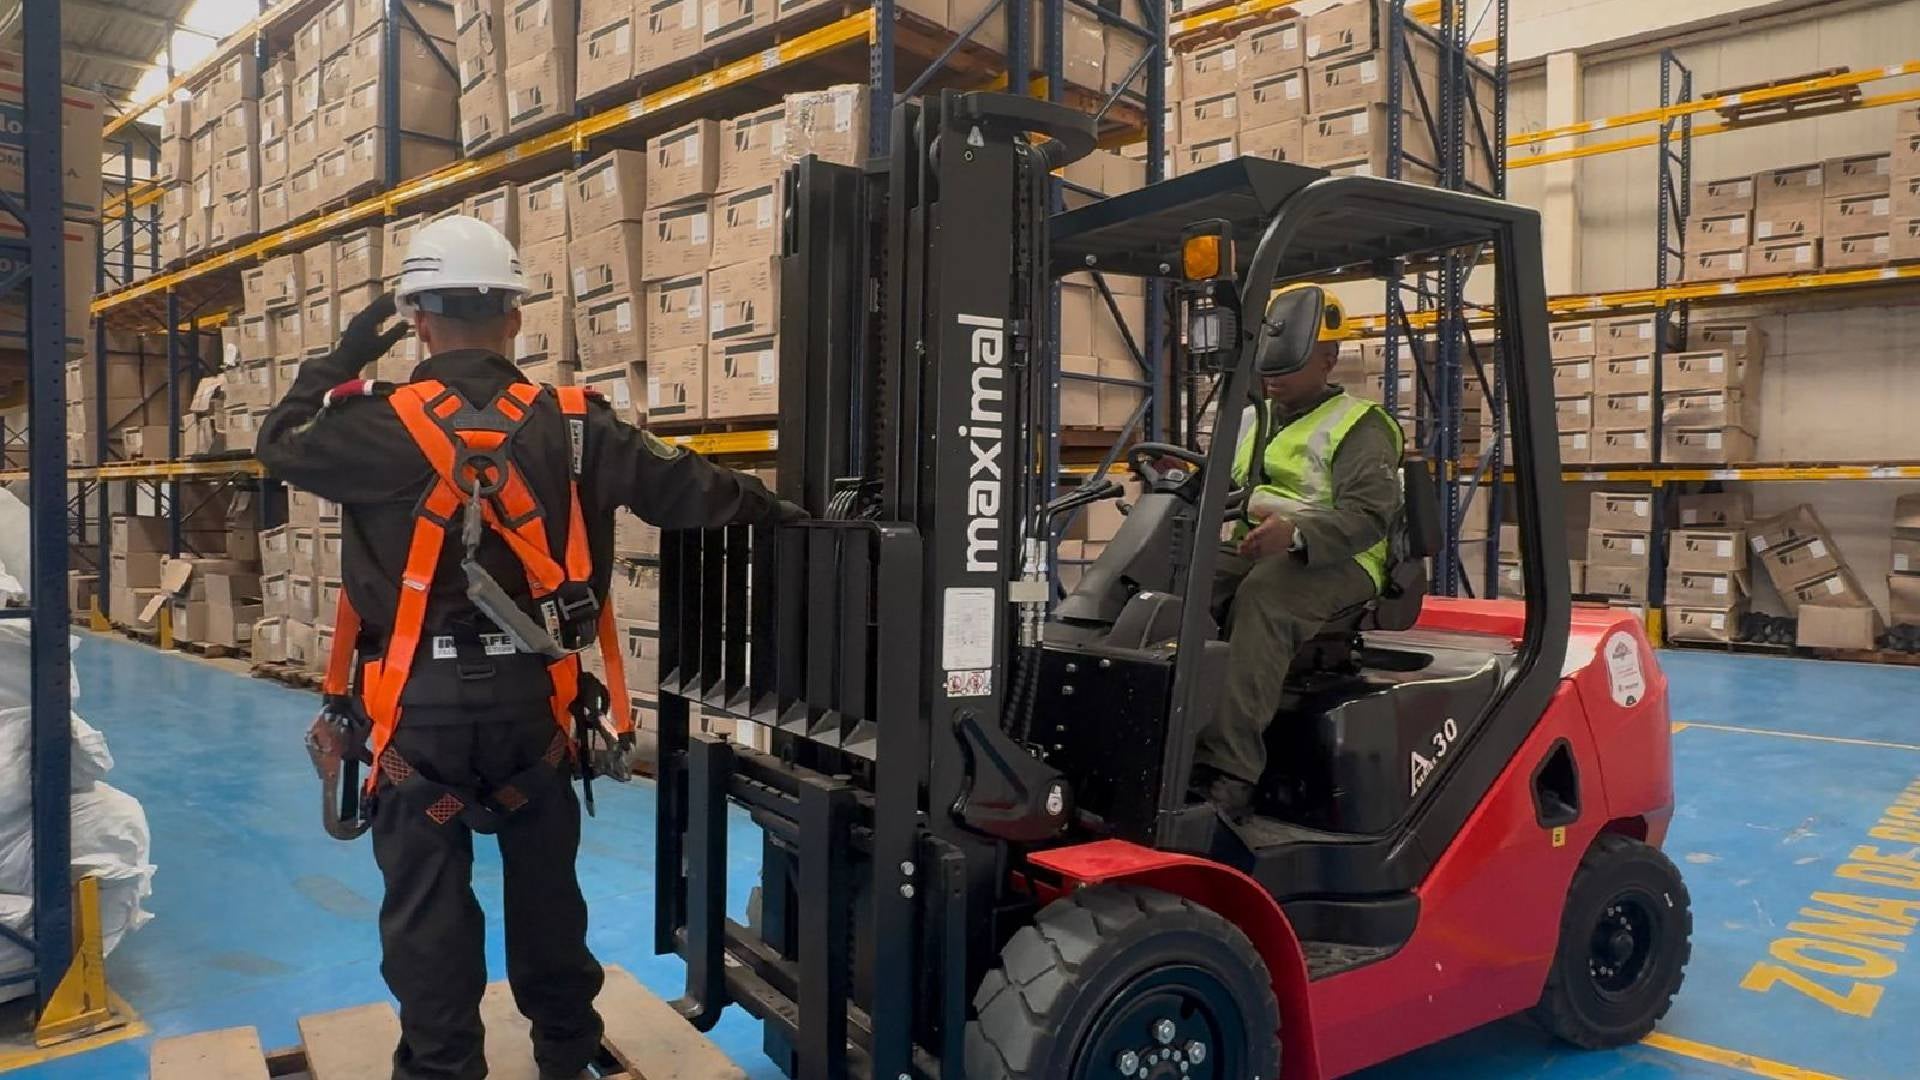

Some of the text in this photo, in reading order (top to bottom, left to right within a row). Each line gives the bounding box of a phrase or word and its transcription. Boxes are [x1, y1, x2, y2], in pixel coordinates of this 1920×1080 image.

[957, 313, 1004, 572] maximal
[1739, 844, 1920, 1019] ZONA DE
